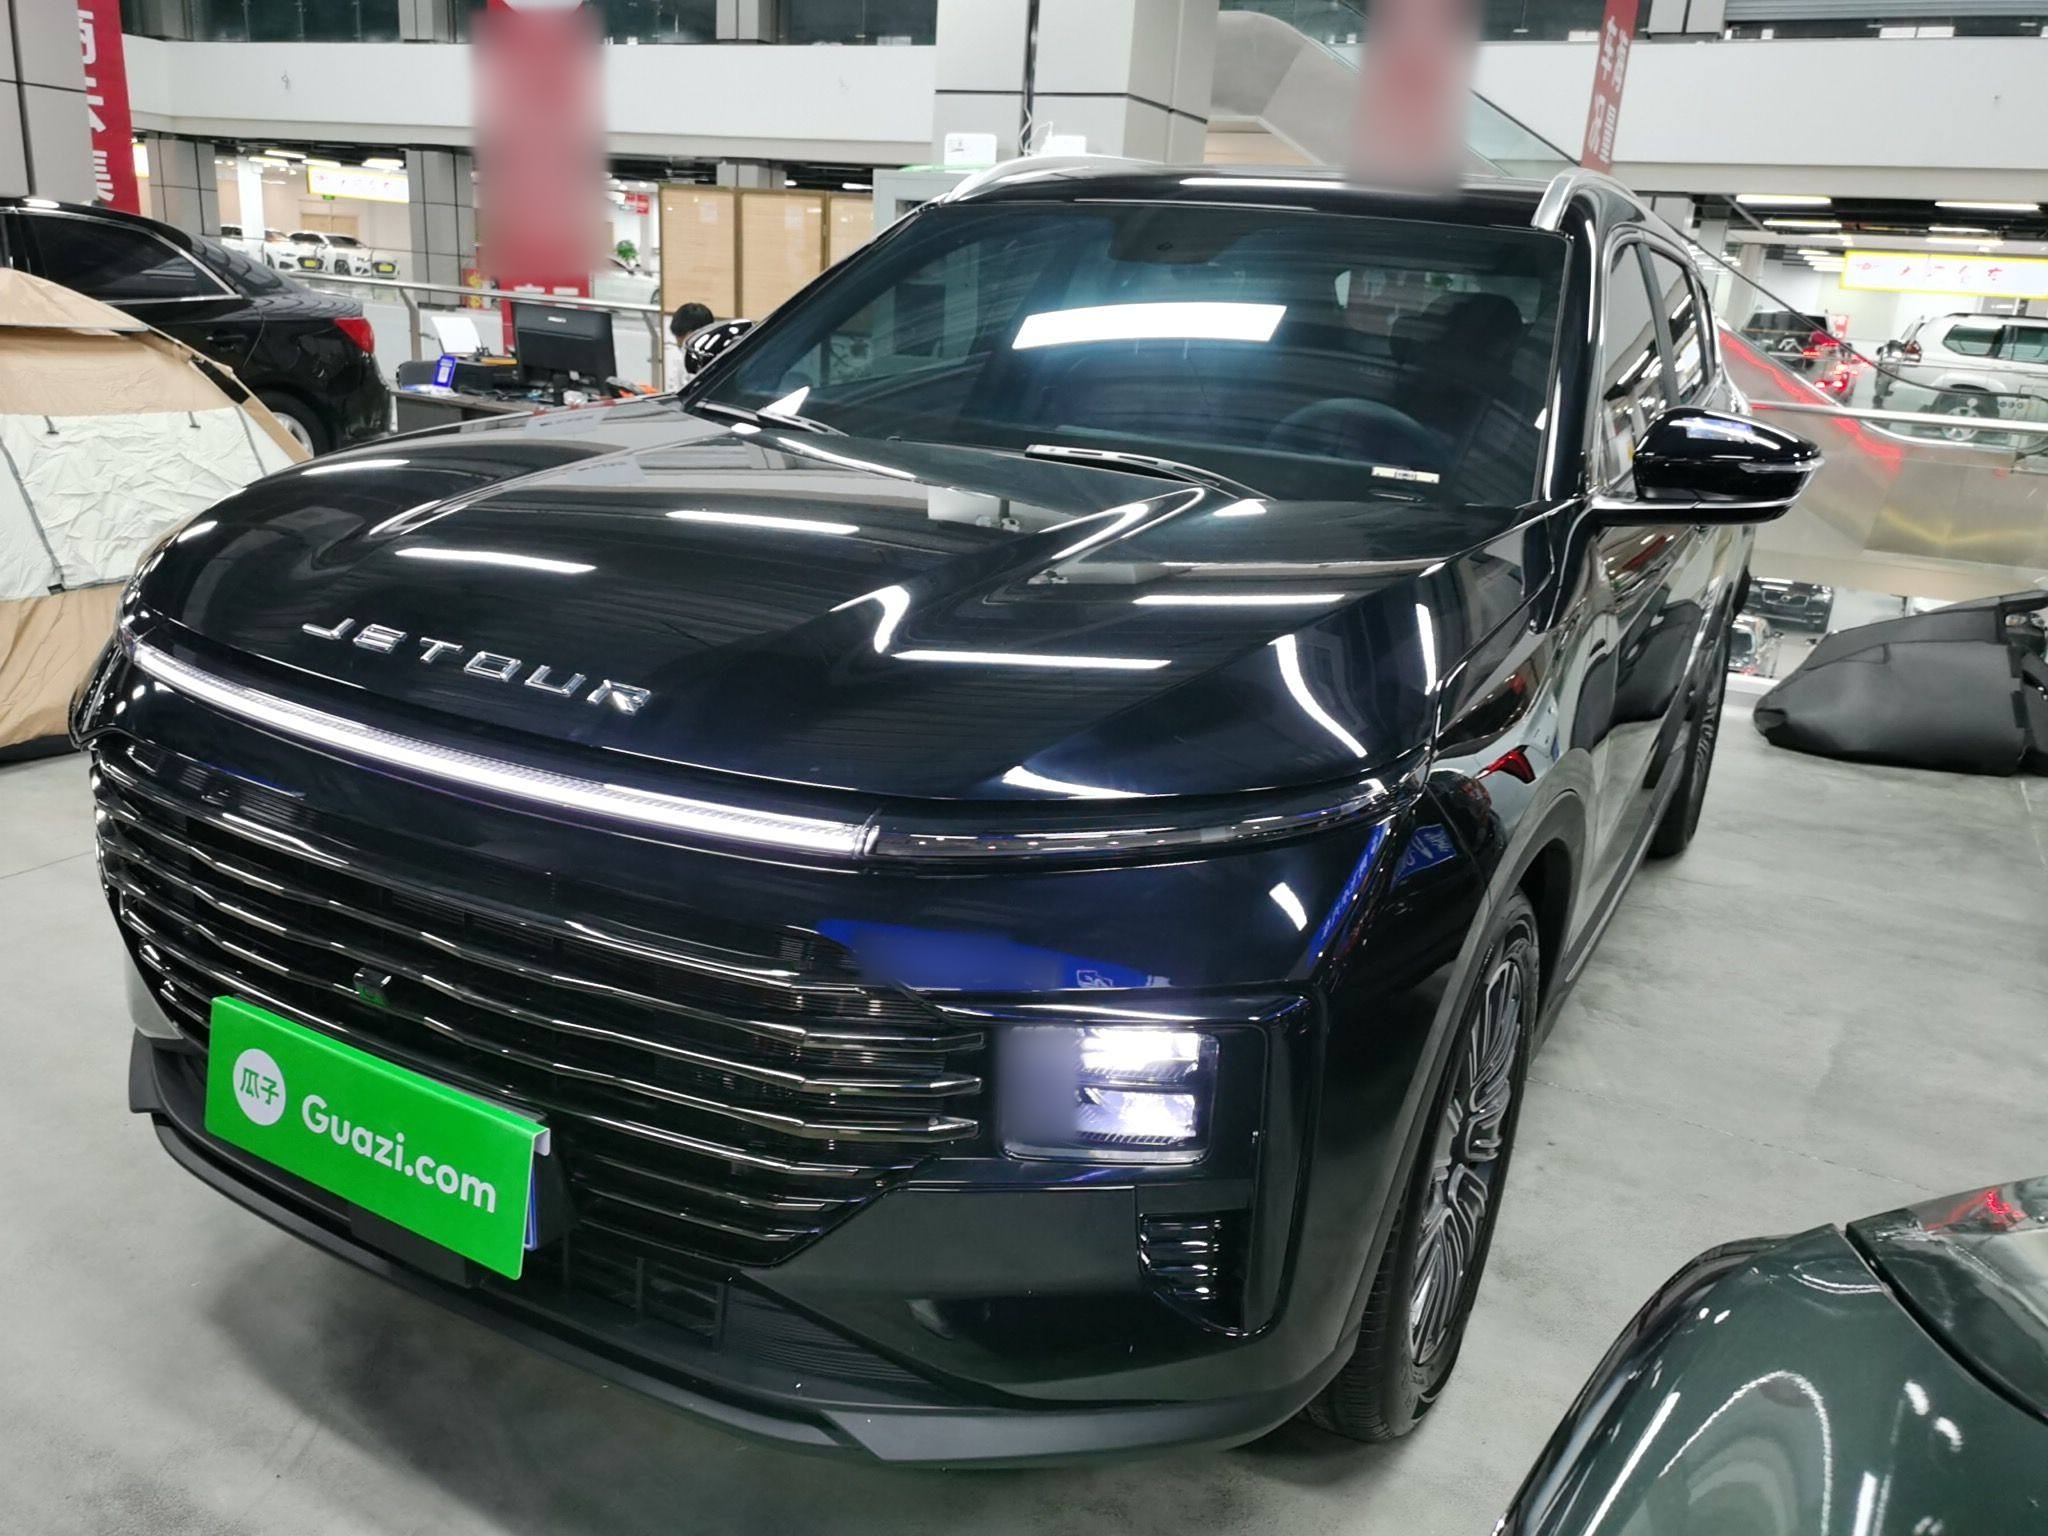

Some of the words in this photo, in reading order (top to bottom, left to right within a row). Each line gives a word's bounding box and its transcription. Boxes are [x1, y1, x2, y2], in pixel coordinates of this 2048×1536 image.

[302, 618, 651, 715] JETOUR
[239, 1067, 280, 1105] 瓜子
[302, 1094, 496, 1213] Guazi.com
